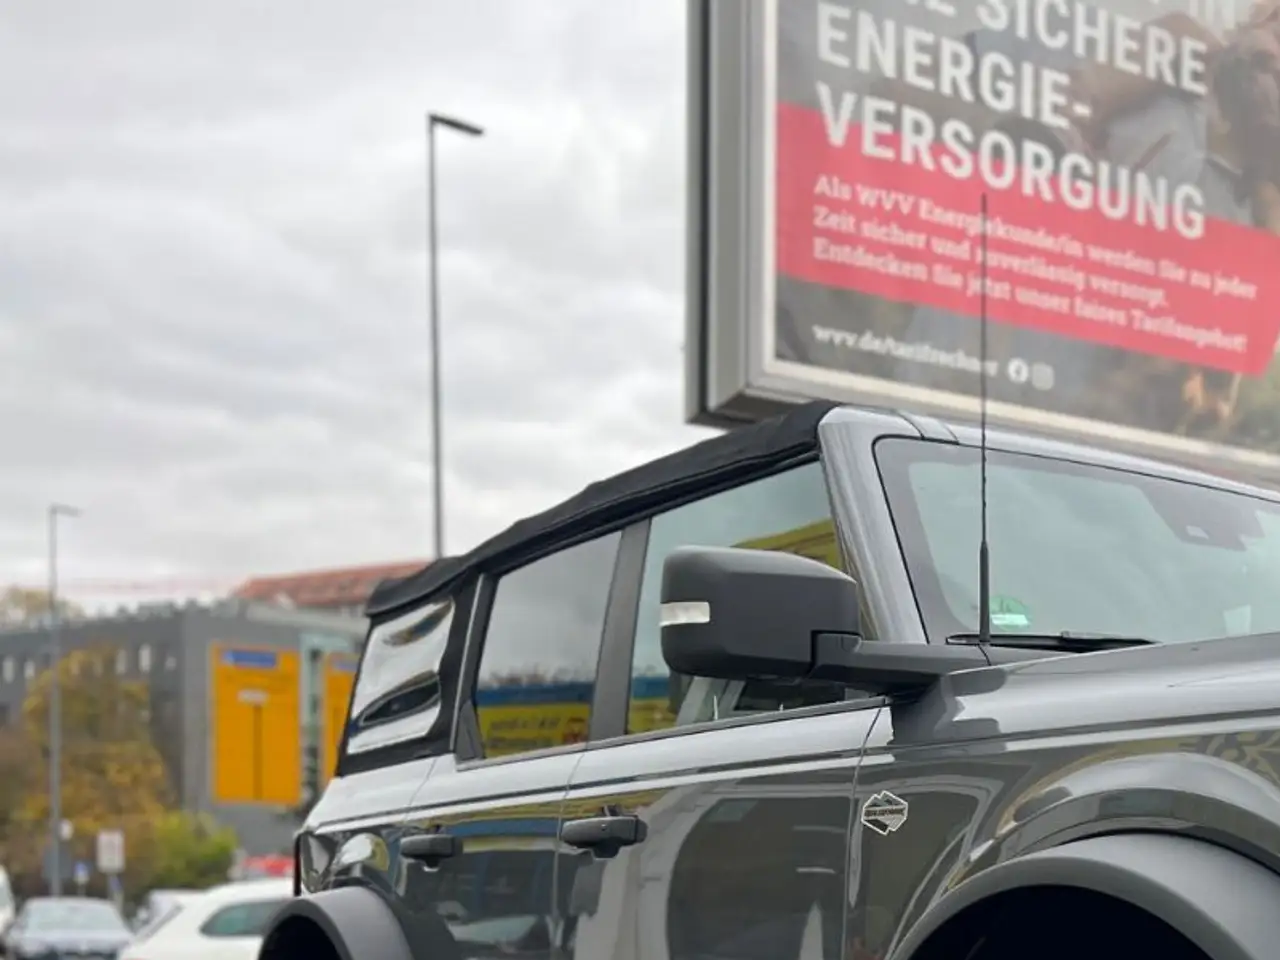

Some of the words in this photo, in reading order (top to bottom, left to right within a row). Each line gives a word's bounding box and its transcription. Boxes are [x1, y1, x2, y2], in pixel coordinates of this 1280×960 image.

[816, 4, 1092, 129] ENERGIE-
[976, 0, 1208, 96] SICHERE
[816, 81, 1206, 239] VERSORGUNG
[813, 174, 851, 200] Als
[856, 183, 914, 215] WVV
[1087, 244, 1155, 276] werden
[1158, 259, 1187, 282] Sie
[813, 205, 856, 233] Zeit
[860, 218, 928, 248] sicher
[930, 235, 970, 260] und
[813, 237, 928, 282] Entdecken
[932, 263, 963, 288] Sie
